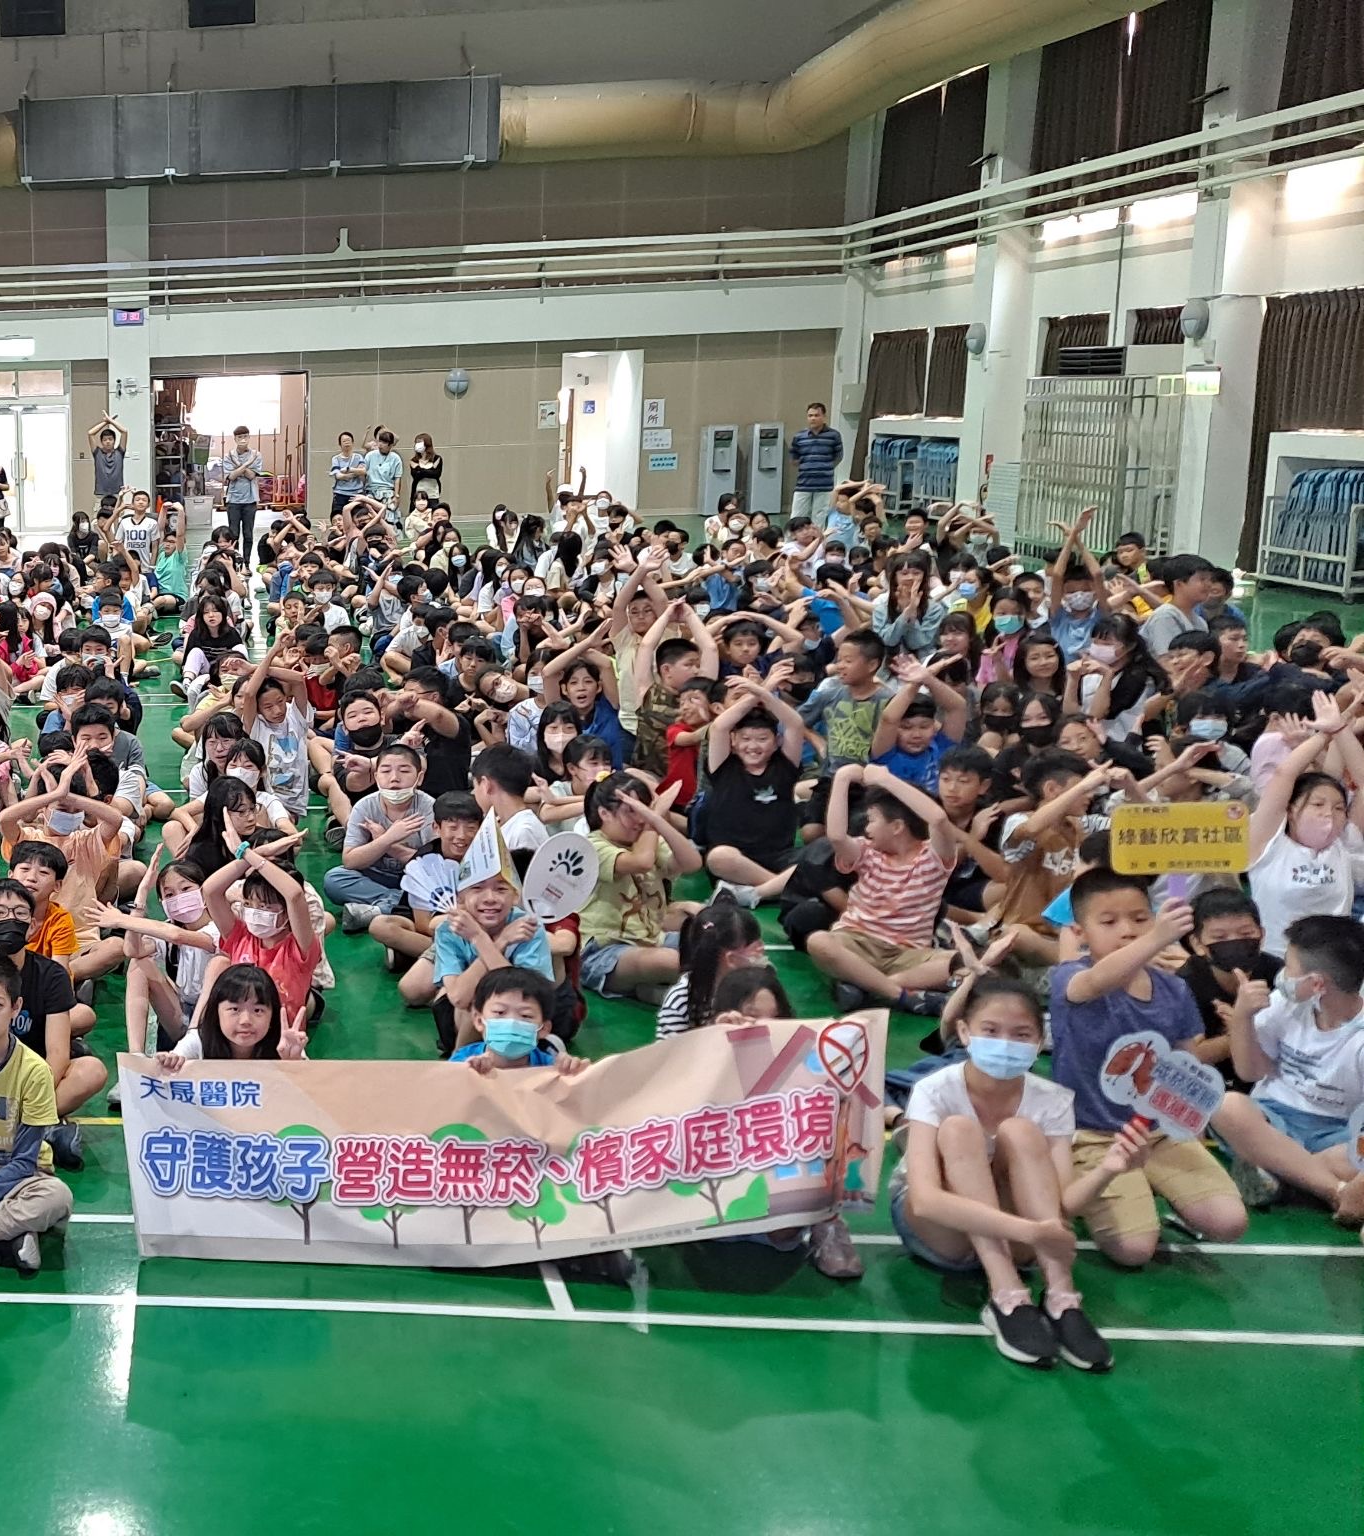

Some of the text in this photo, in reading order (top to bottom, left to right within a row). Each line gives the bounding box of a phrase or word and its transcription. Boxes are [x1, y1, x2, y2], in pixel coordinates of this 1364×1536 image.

[126, 529, 147, 541] 100
[140, 1075, 262, 1107] 天晟醫院
